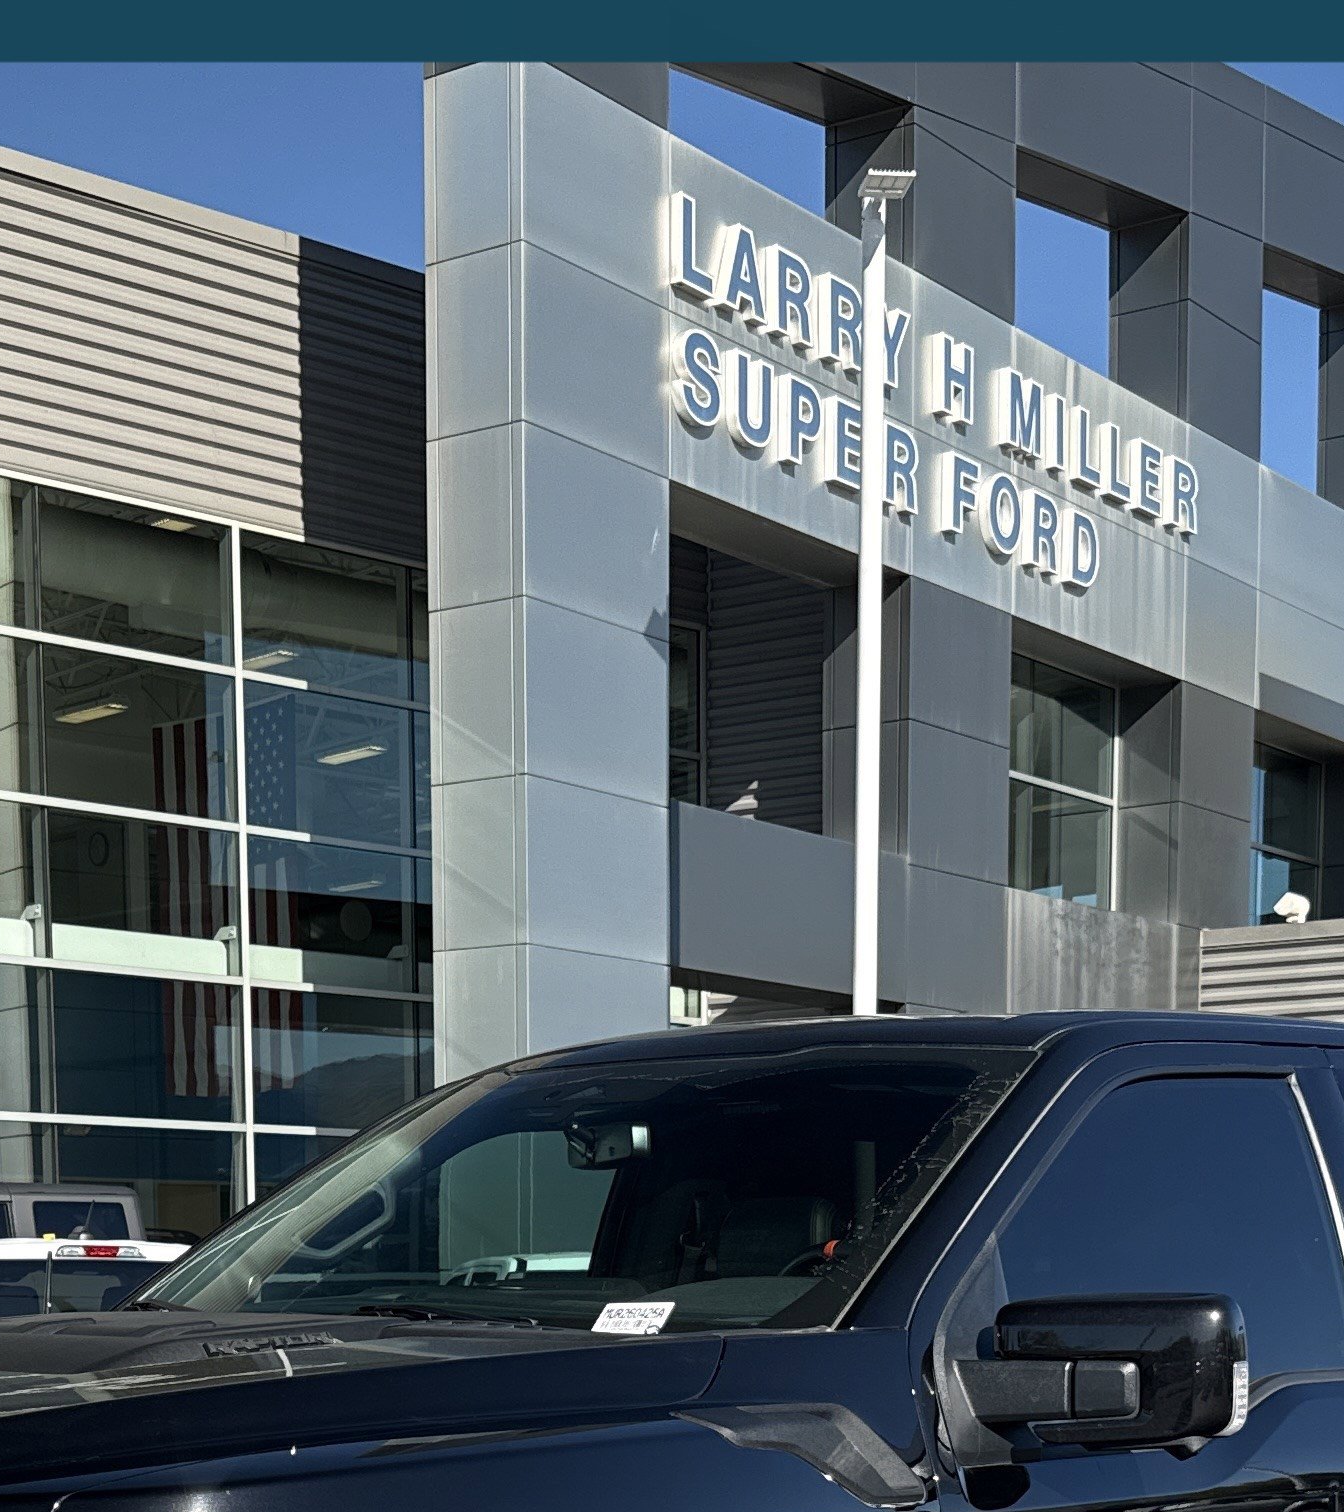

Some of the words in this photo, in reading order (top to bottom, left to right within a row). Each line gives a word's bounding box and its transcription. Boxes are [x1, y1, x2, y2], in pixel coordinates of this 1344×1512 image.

[669, 190, 912, 390] LARRY
[933, 332, 975, 426] H
[998, 366, 1200, 536] MILLER
[673, 328, 919, 517] SUPER
[941, 450, 1100, 588] FORD
